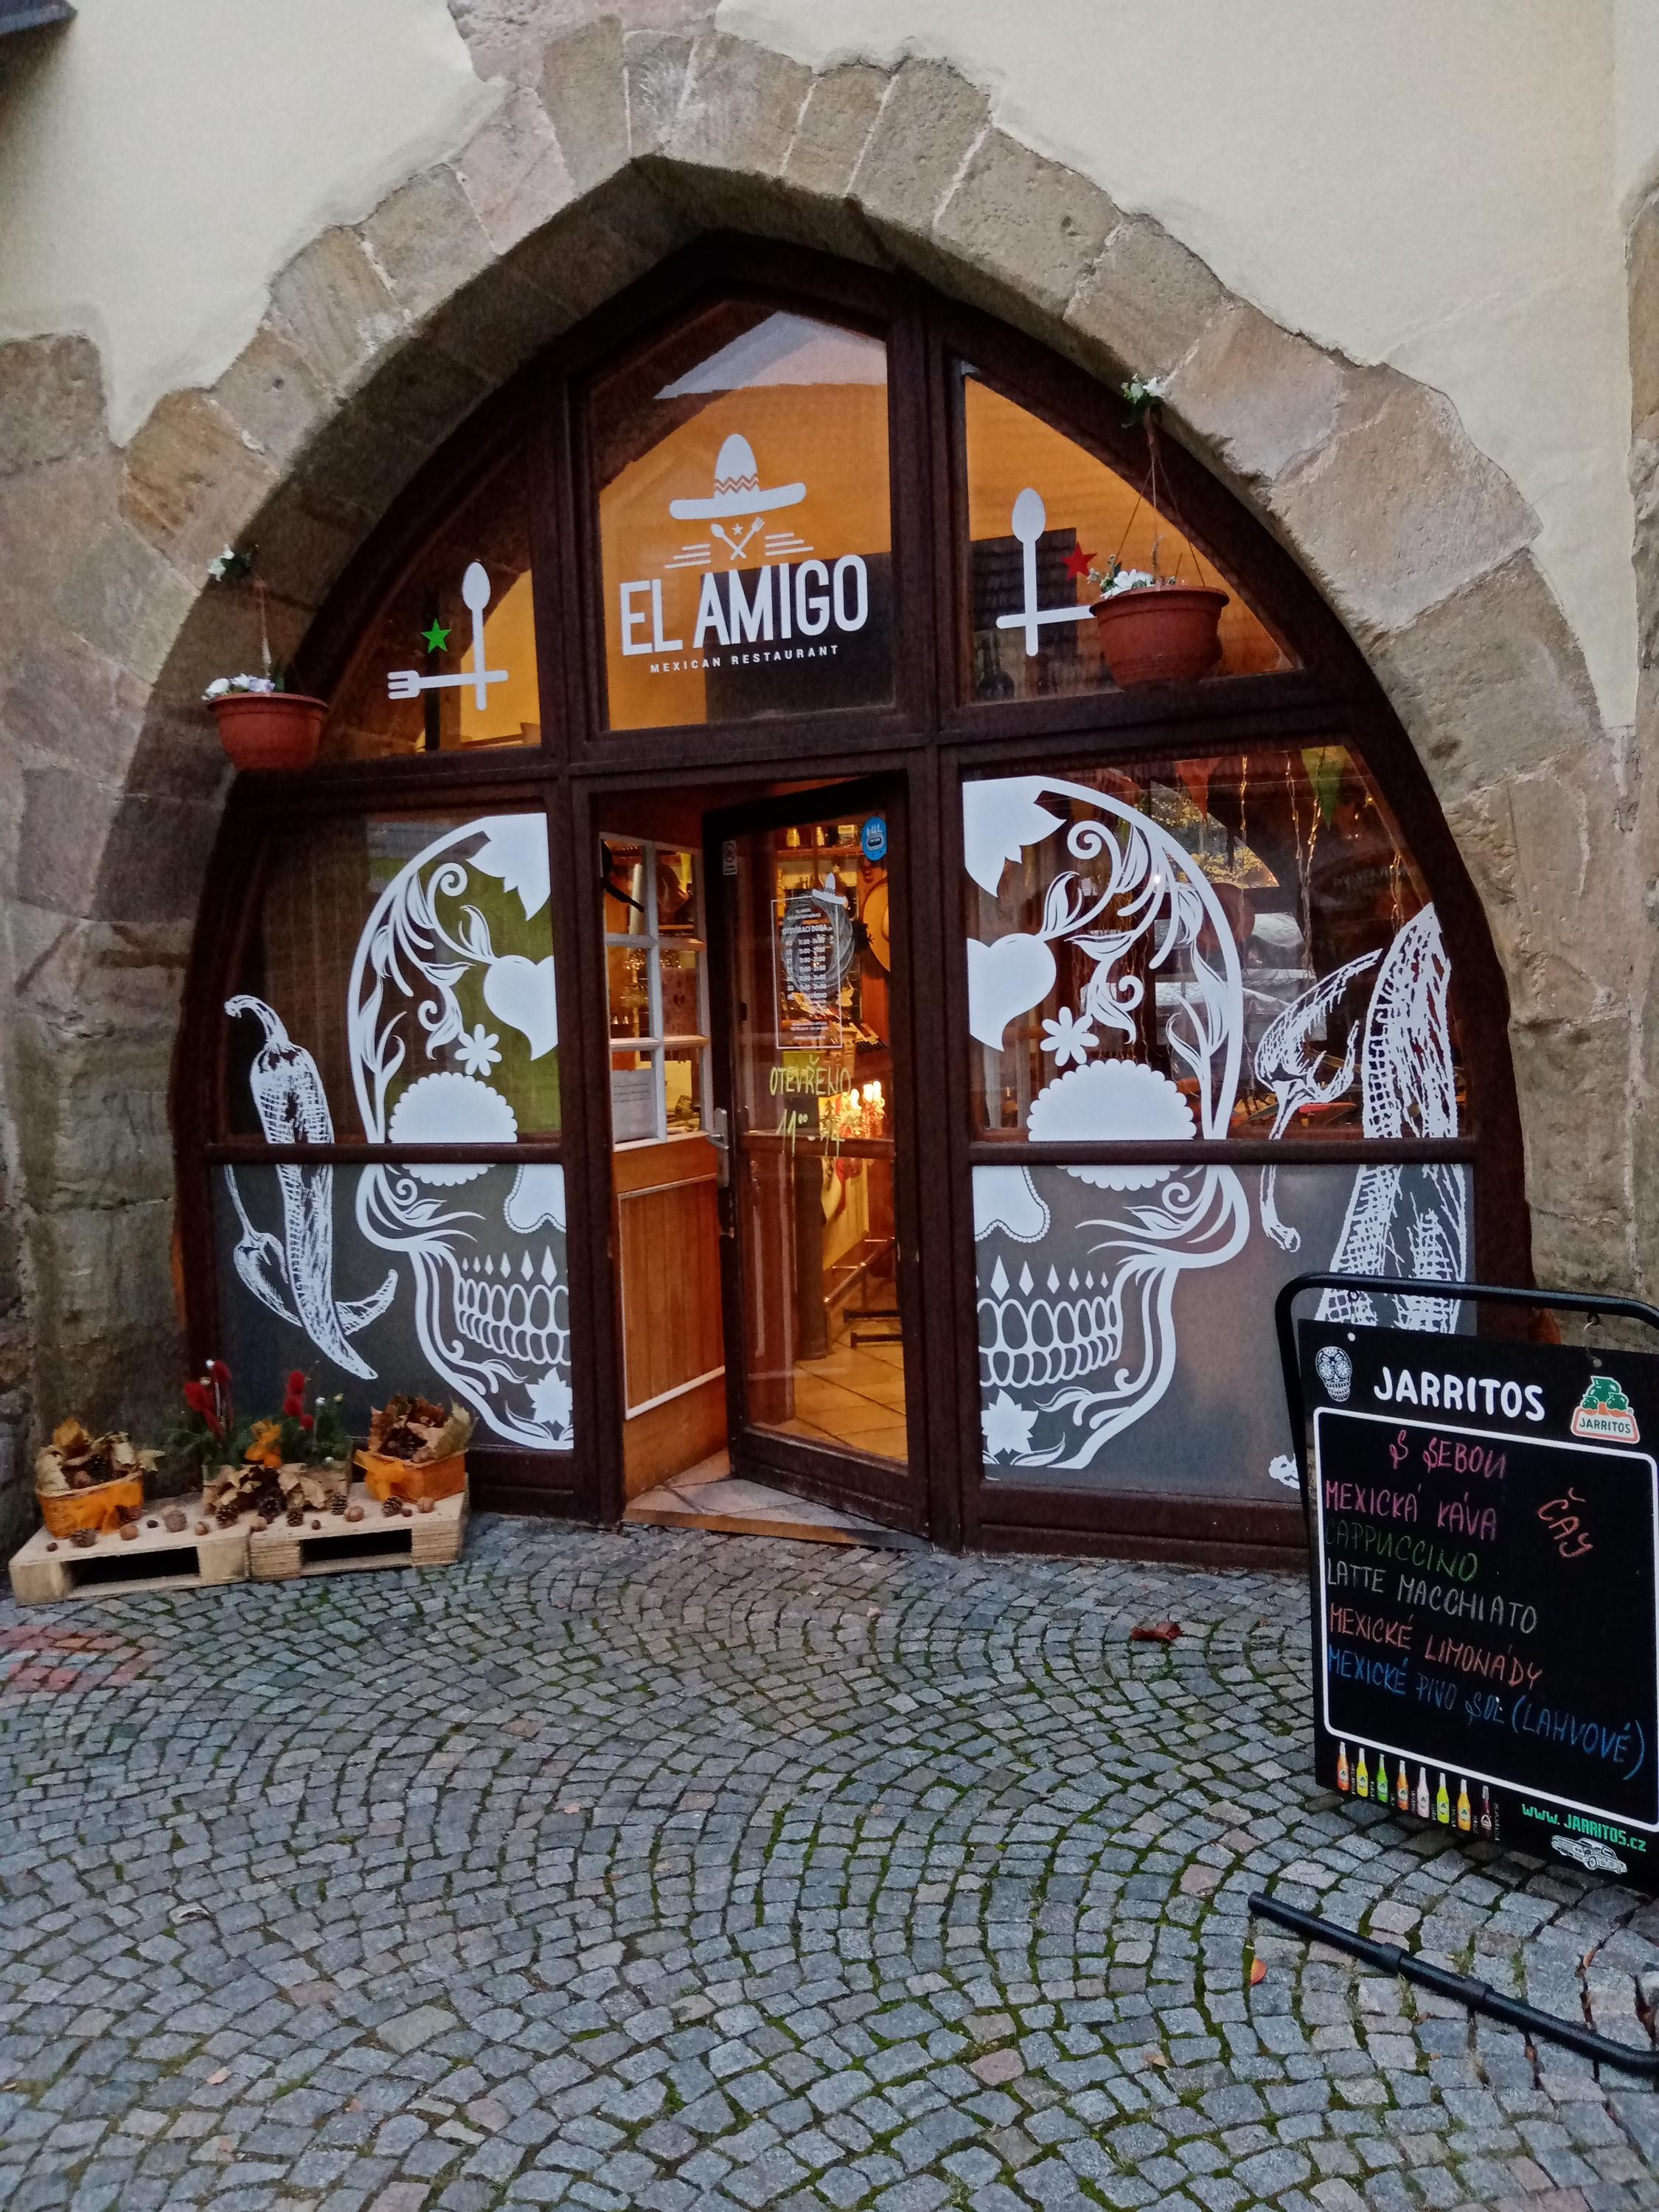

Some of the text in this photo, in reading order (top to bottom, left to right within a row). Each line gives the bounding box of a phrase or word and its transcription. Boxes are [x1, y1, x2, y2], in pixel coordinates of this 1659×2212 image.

[619, 554, 869, 655] EL AMIGO
[650, 645, 839, 674] MEXICAN RESTAURANT
[770, 1054, 852, 1096] OTEVŘENO
[1374, 1366, 1545, 1422] JARRITOS
[1579, 1417, 1631, 1434] JARRITOS
[1326, 1479, 1497, 1542] MEXICKÁ KÁVA
[1325, 1518, 1478, 1582] CAPPUCCINO
[1327, 1557, 1538, 1635] LATTE MACCHIATO
[1327, 1644, 1408, 1695] MEXICKÉ
[1416, 1672, 1458, 1711] PIVO
[1329, 1602, 1544, 1691] MEXICKÉ LIMONÁDY
